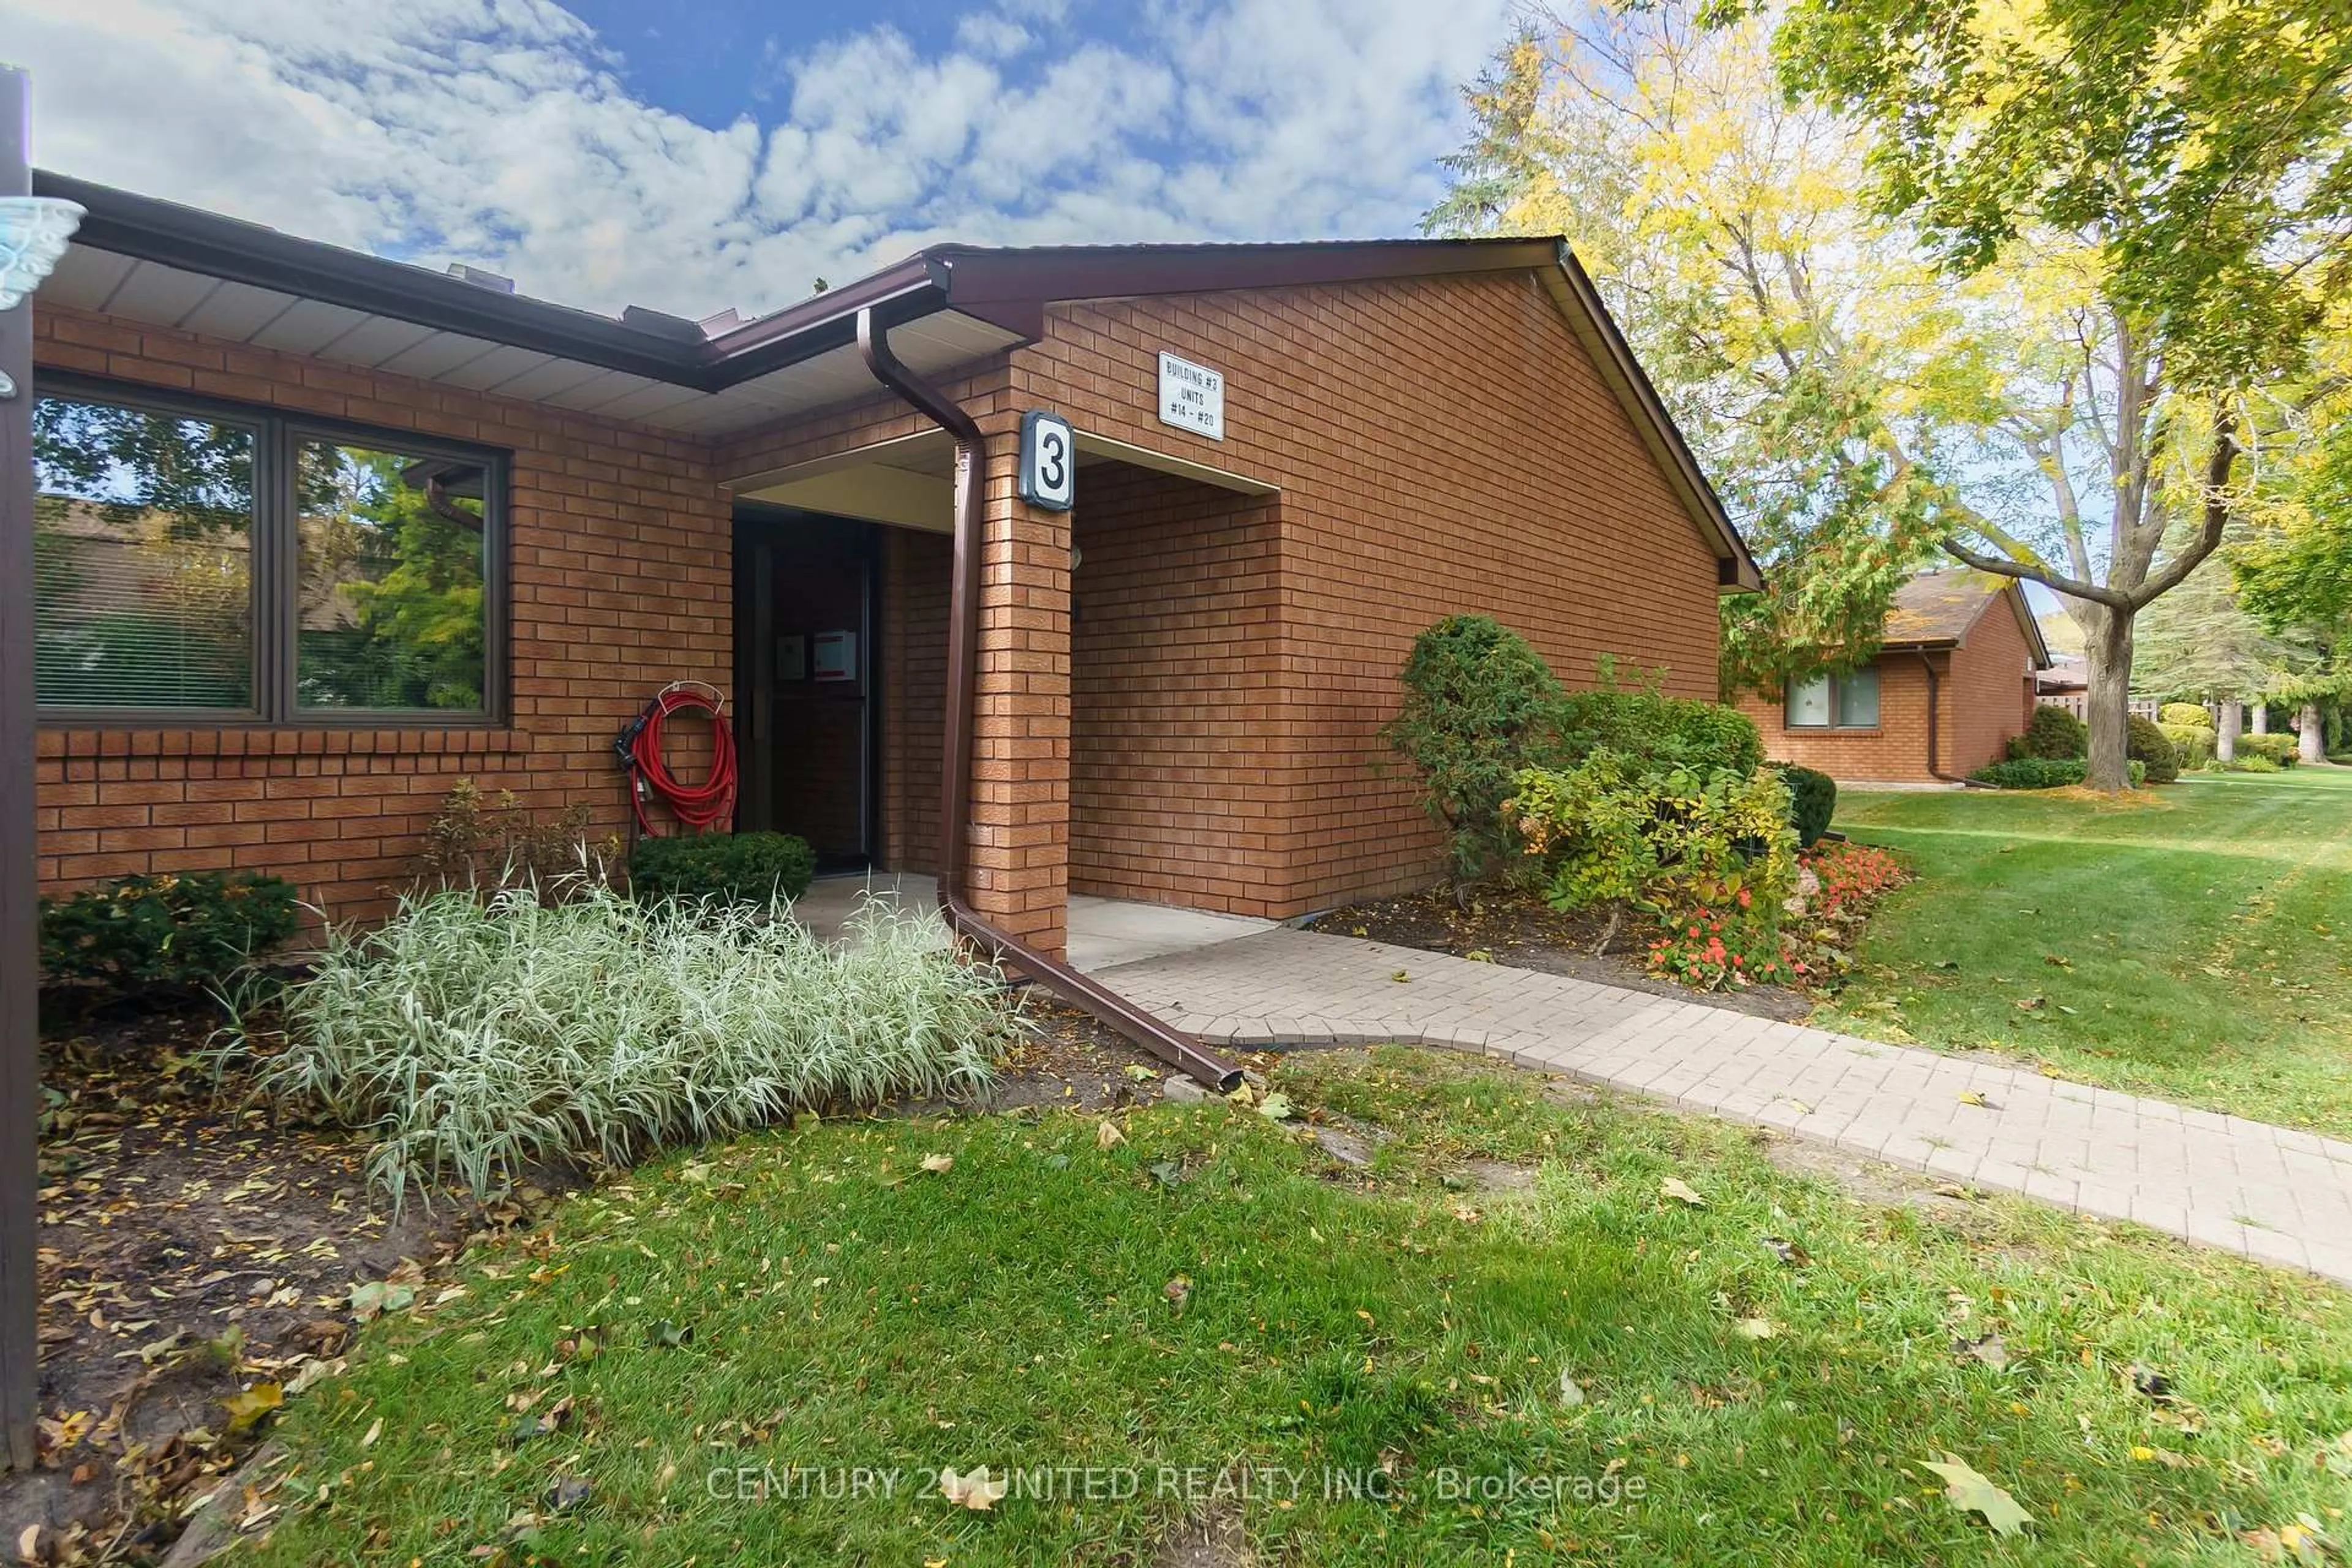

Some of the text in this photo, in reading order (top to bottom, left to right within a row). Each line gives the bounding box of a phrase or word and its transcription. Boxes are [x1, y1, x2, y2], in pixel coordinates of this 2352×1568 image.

[1167, 361, 1217, 391] BUILDING #3
[1181, 387, 1204, 405] UNITS
[1171, 402, 1185, 418] #14
[1197, 410, 1214, 426] #20
[1041, 432, 1064, 490] 3
